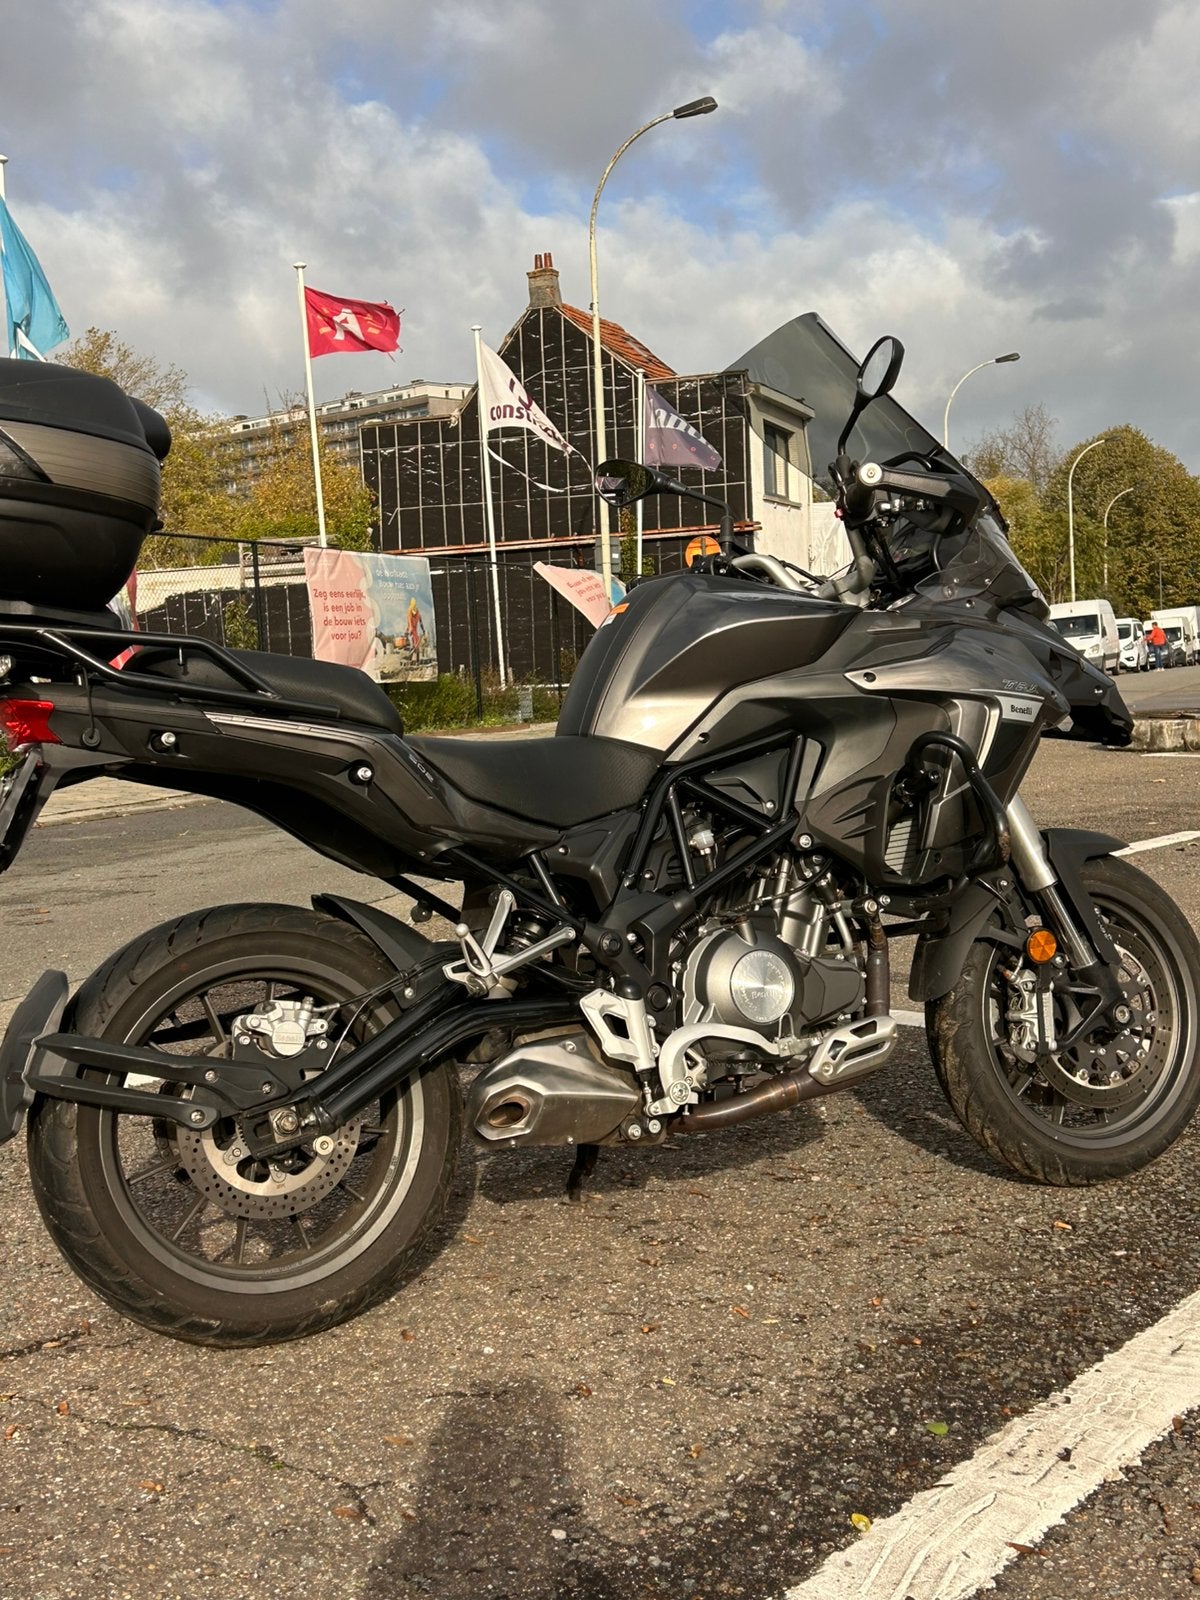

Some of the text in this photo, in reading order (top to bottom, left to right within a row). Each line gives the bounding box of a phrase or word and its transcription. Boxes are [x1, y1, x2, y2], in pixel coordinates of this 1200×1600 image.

[313, 588, 328, 600] Zeg
[323, 602, 363, 614] is een job in
[323, 616, 366, 626] de bouw iets
[331, 630, 362, 642] voor jou?
